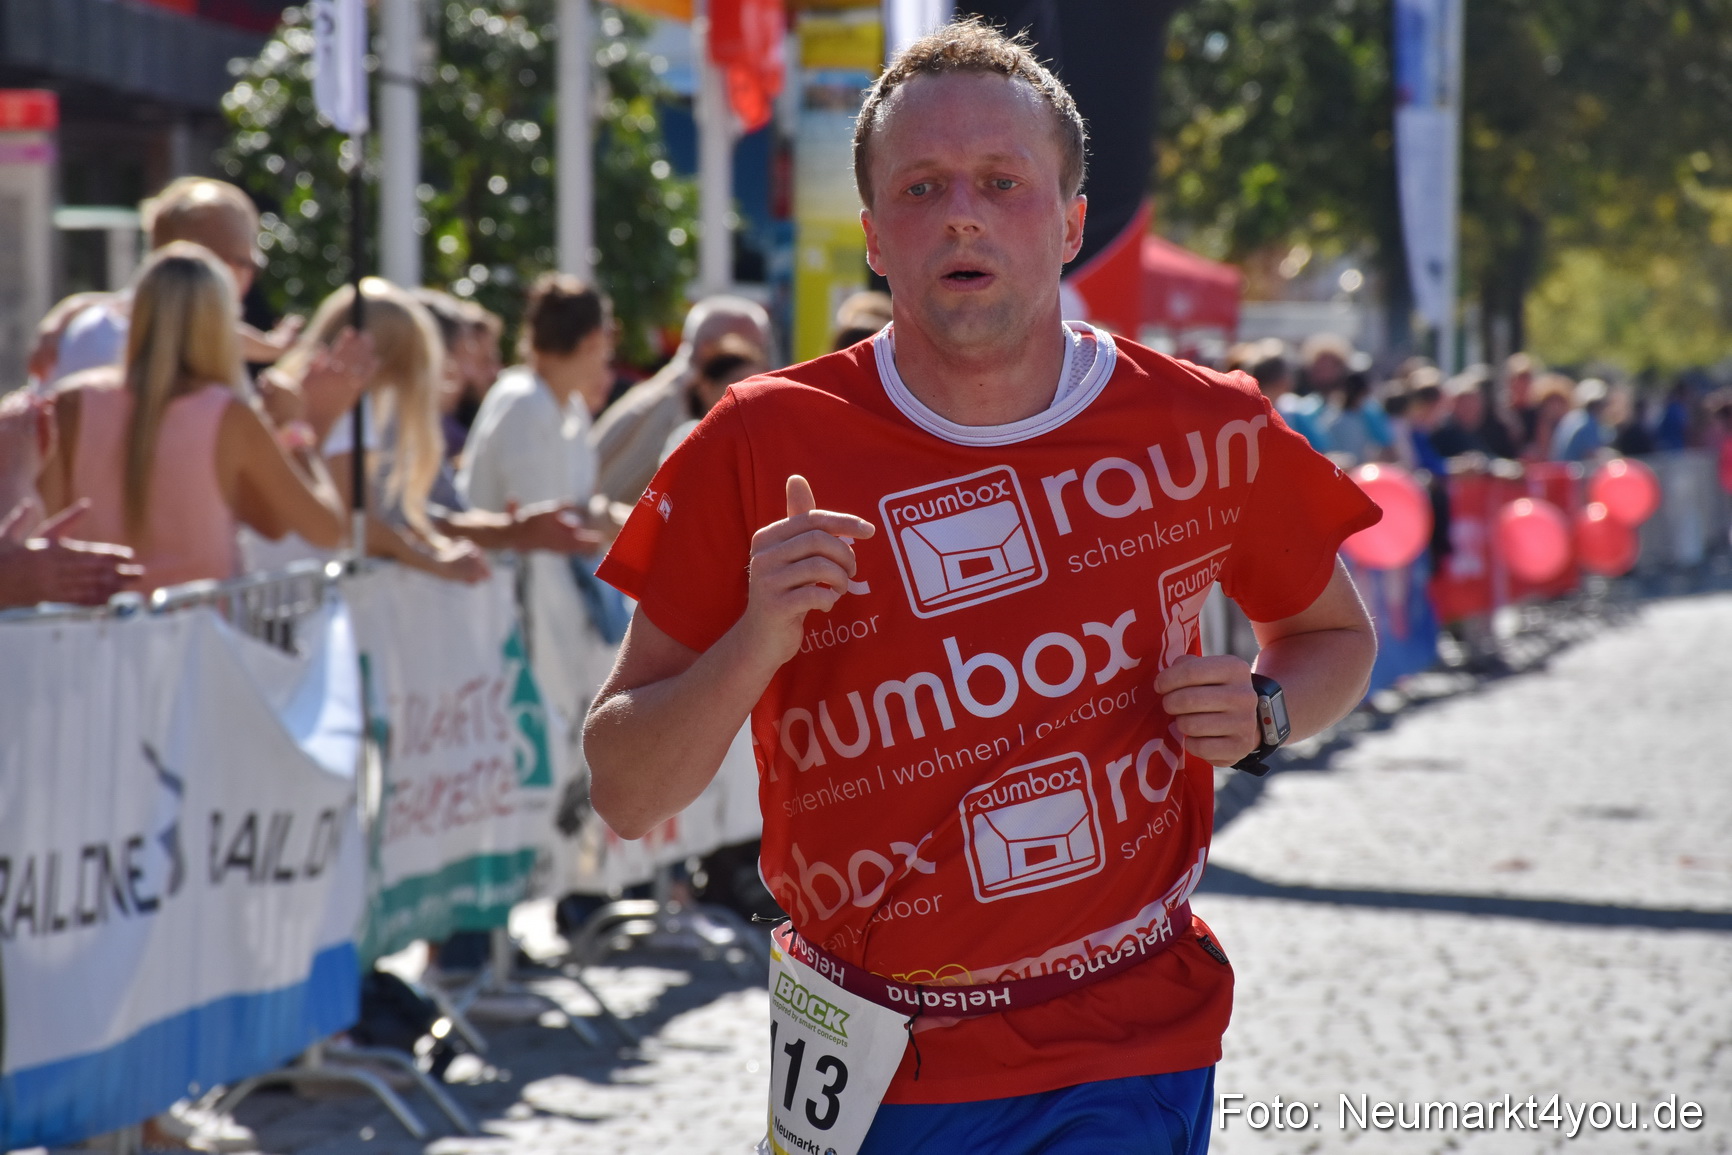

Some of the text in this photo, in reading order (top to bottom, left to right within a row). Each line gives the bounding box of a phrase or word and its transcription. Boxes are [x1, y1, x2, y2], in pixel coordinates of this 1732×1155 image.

[892, 479, 1010, 525] raumbox
[1068, 518, 1200, 573] schenken
[800, 614, 879, 653] utdoor
[893, 735, 1010, 785] wohnen
[970, 767, 1081, 812] raumbox
[1067, 917, 1173, 980] Helsana
[774, 971, 850, 1039] BOCK
[886, 985, 1011, 1012] Helsana
[791, 1009, 800, 1022] by
[817, 1029, 848, 1048] concepts
[774, 1116, 821, 1155] Neumarkt
